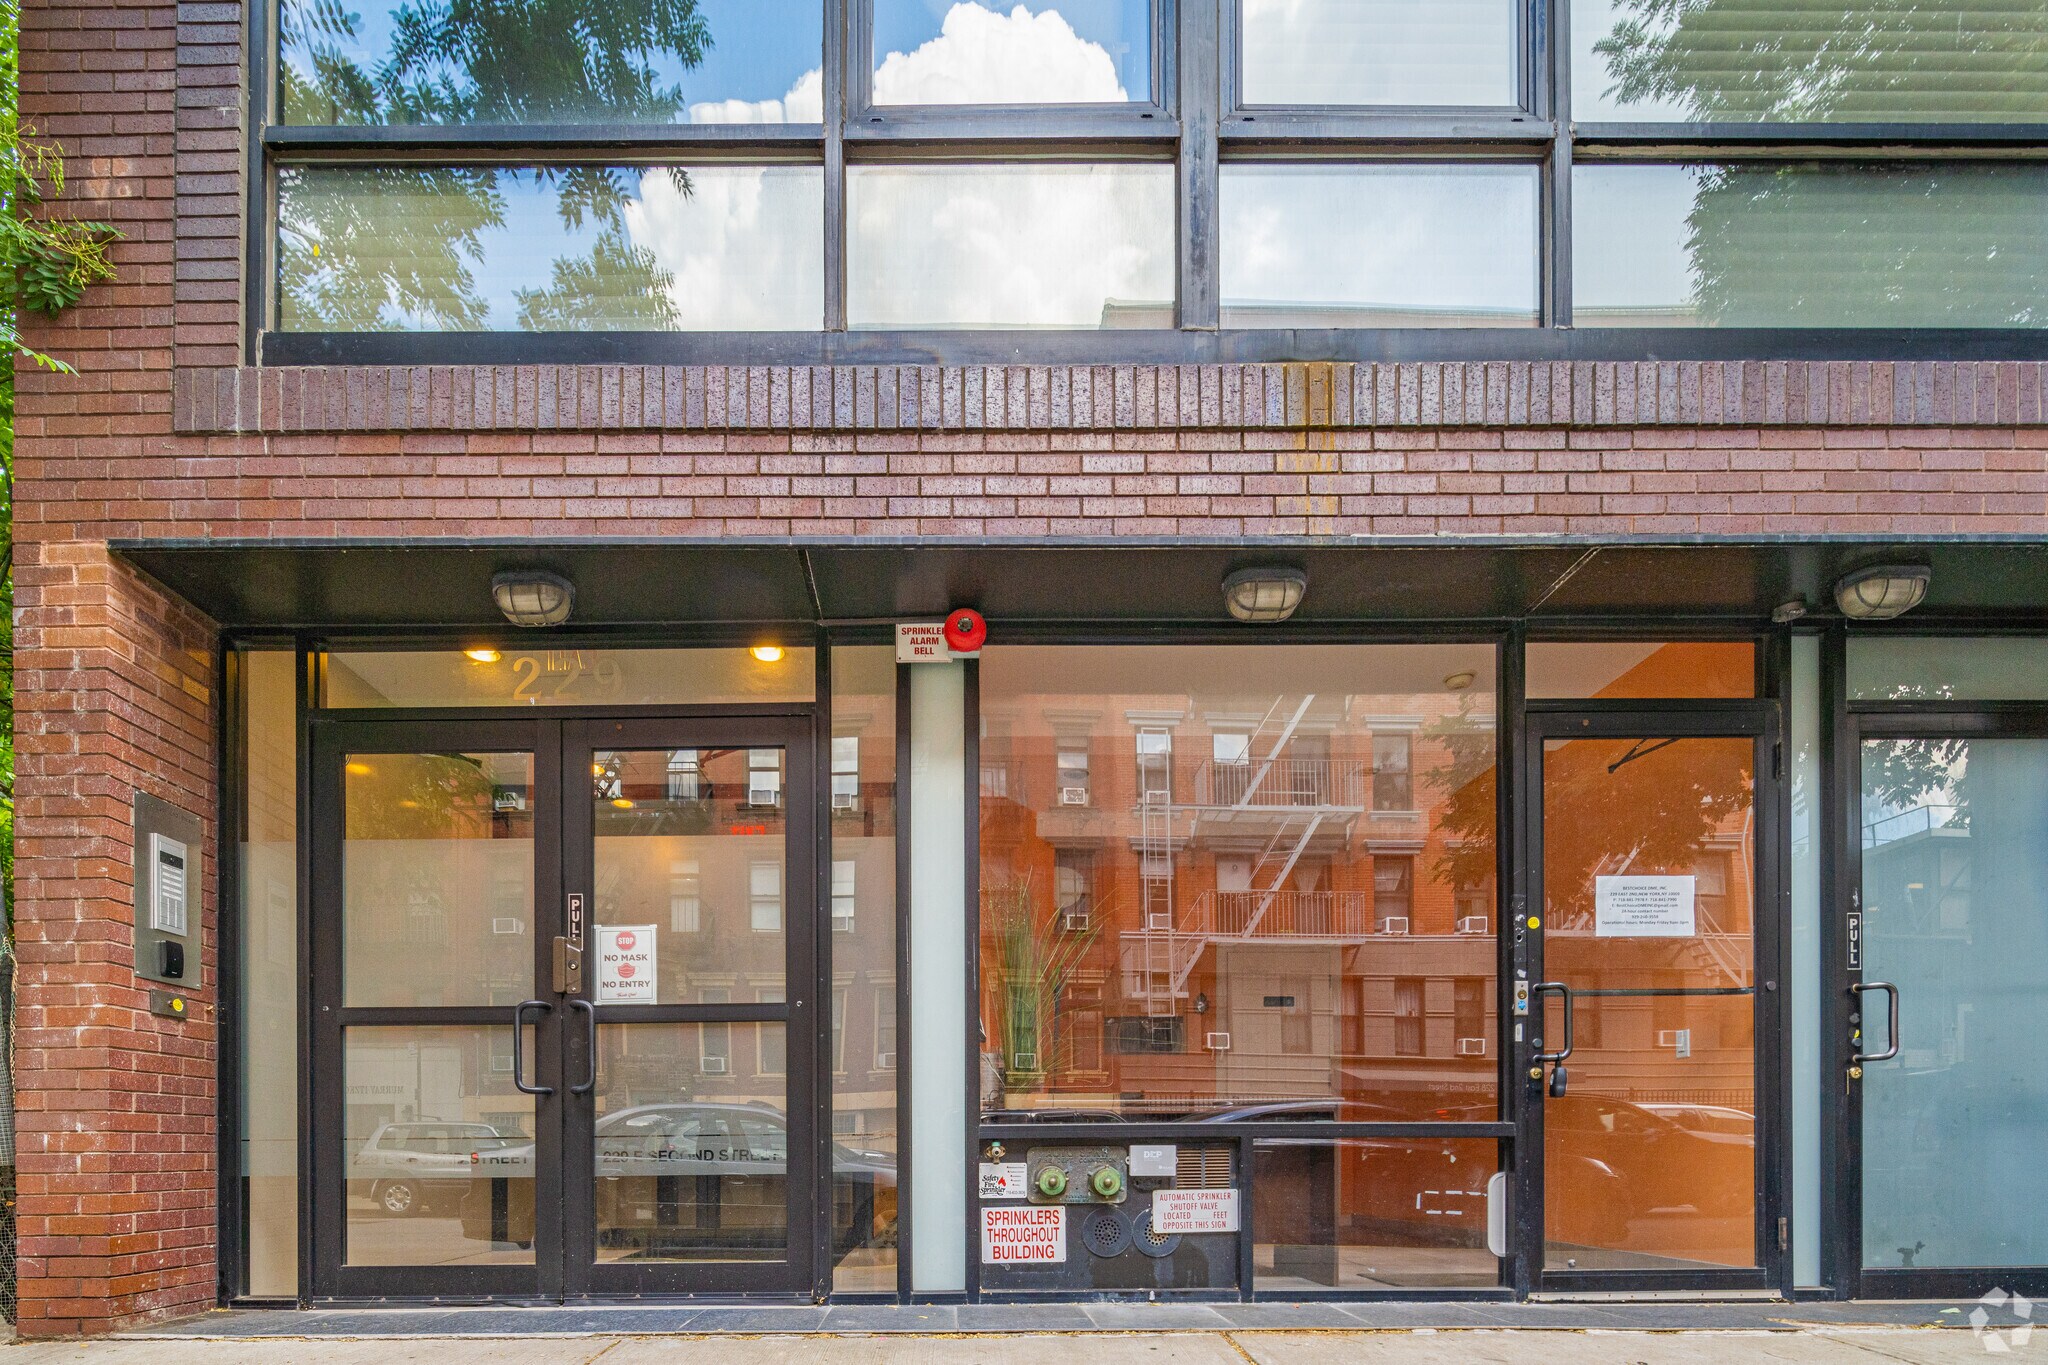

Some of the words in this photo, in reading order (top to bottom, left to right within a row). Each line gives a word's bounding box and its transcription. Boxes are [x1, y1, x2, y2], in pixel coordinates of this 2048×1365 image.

[910, 637, 939, 645] ALARM
[914, 647, 934, 655] BELL
[571, 899, 580, 938] PUL
[618, 937, 634, 945] STOP
[1849, 918, 1858, 964] PULL
[604, 954, 619, 962] NO
[621, 954, 648, 962] MASK
[619, 980, 651, 988] ENTRY
[1159, 1193, 1195, 1201] AUTOMATIC
[1197, 1192, 1232, 1200] SPRINKLER
[1169, 1203, 1198, 1211] SHUTOFF
[1200, 1202, 1218, 1210] VALVE
[987, 1210, 1060, 1226] SPRINKLERS
[1163, 1212, 1191, 1220] LOCATED
[1213, 1211, 1228, 1219] FEET
[1162, 1221, 1193, 1230] OPPOSITE
[1195, 1221, 1209, 1229] THIS
[1211, 1220, 1227, 1229] SIGN
[987, 1227, 1060, 1243] THROUGHOUT
[993, 1244, 1055, 1260] BUILDING
